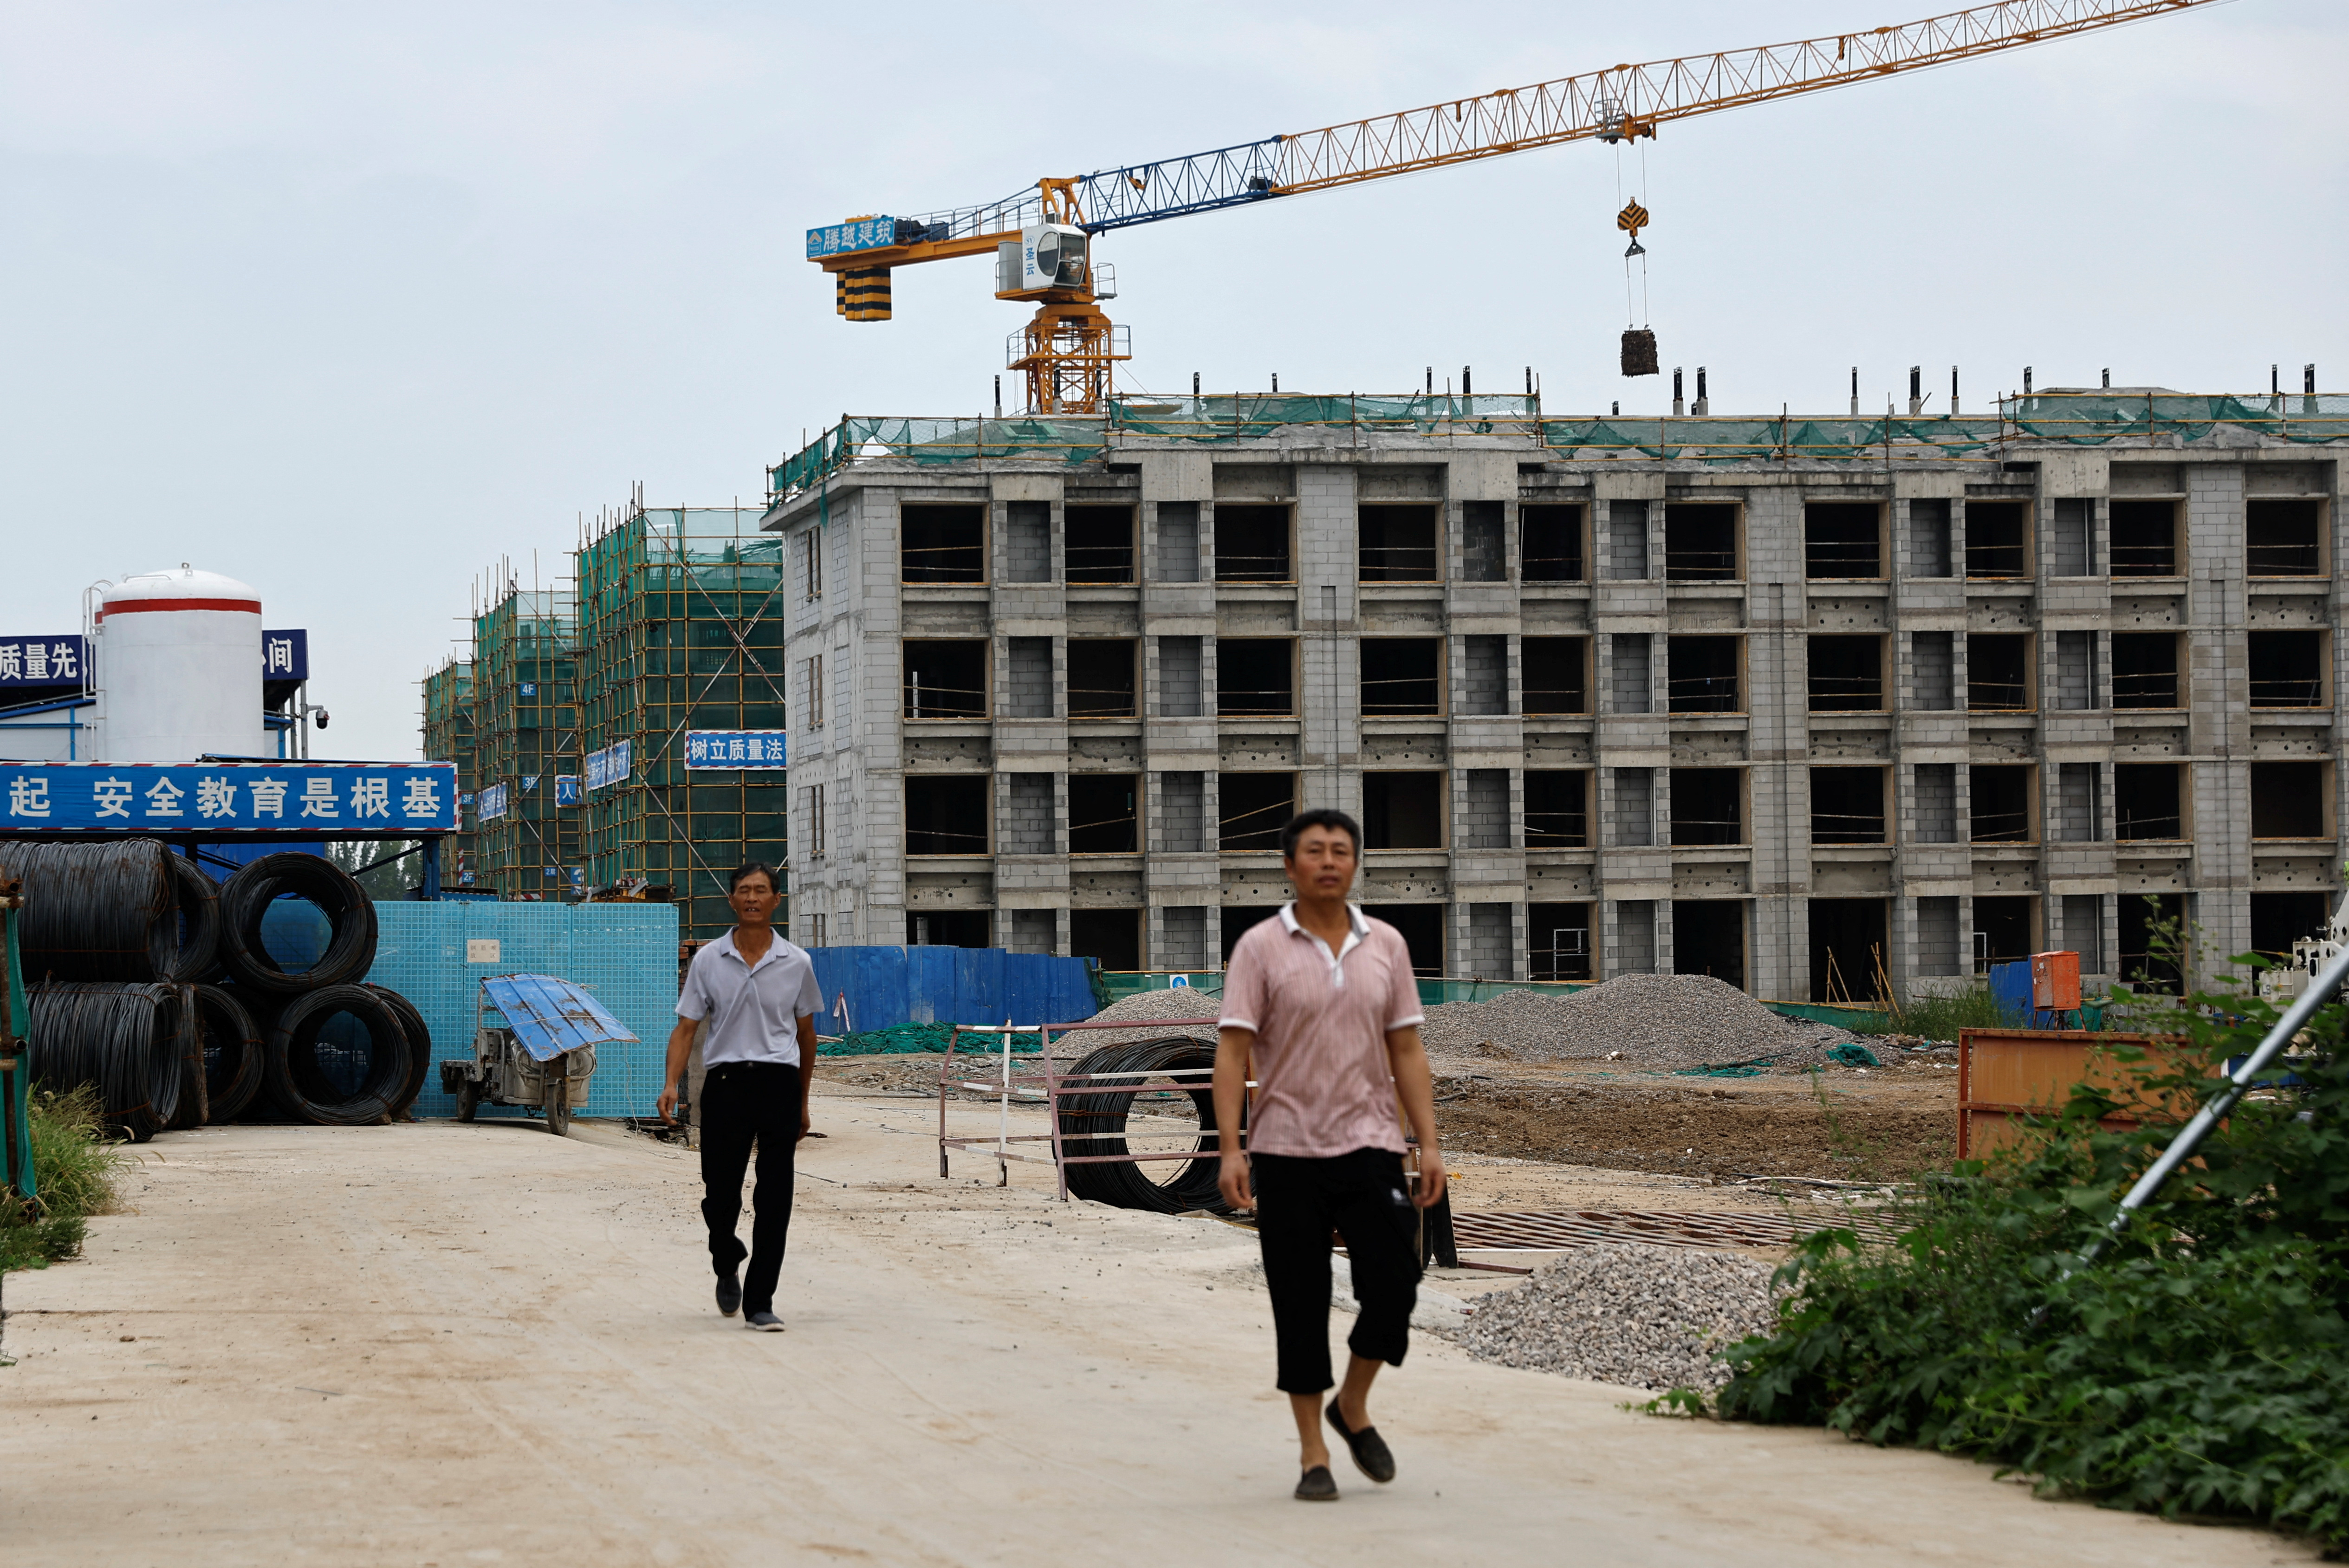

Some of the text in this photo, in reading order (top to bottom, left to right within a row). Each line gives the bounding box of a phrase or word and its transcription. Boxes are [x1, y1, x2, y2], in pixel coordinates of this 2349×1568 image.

[824, 220, 893, 252] 腾越建筑
[1026, 247, 1035, 276] 圣云
[0, 637, 292, 680] 质量先 间
[523, 684, 534, 694] 4F
[691, 739, 786, 760] 树立质量法
[525, 777, 536, 786] 3F
[9, 775, 51, 817] 起
[93, 776, 441, 818] 安全教育是根基
[463, 794, 473, 803] 3F
